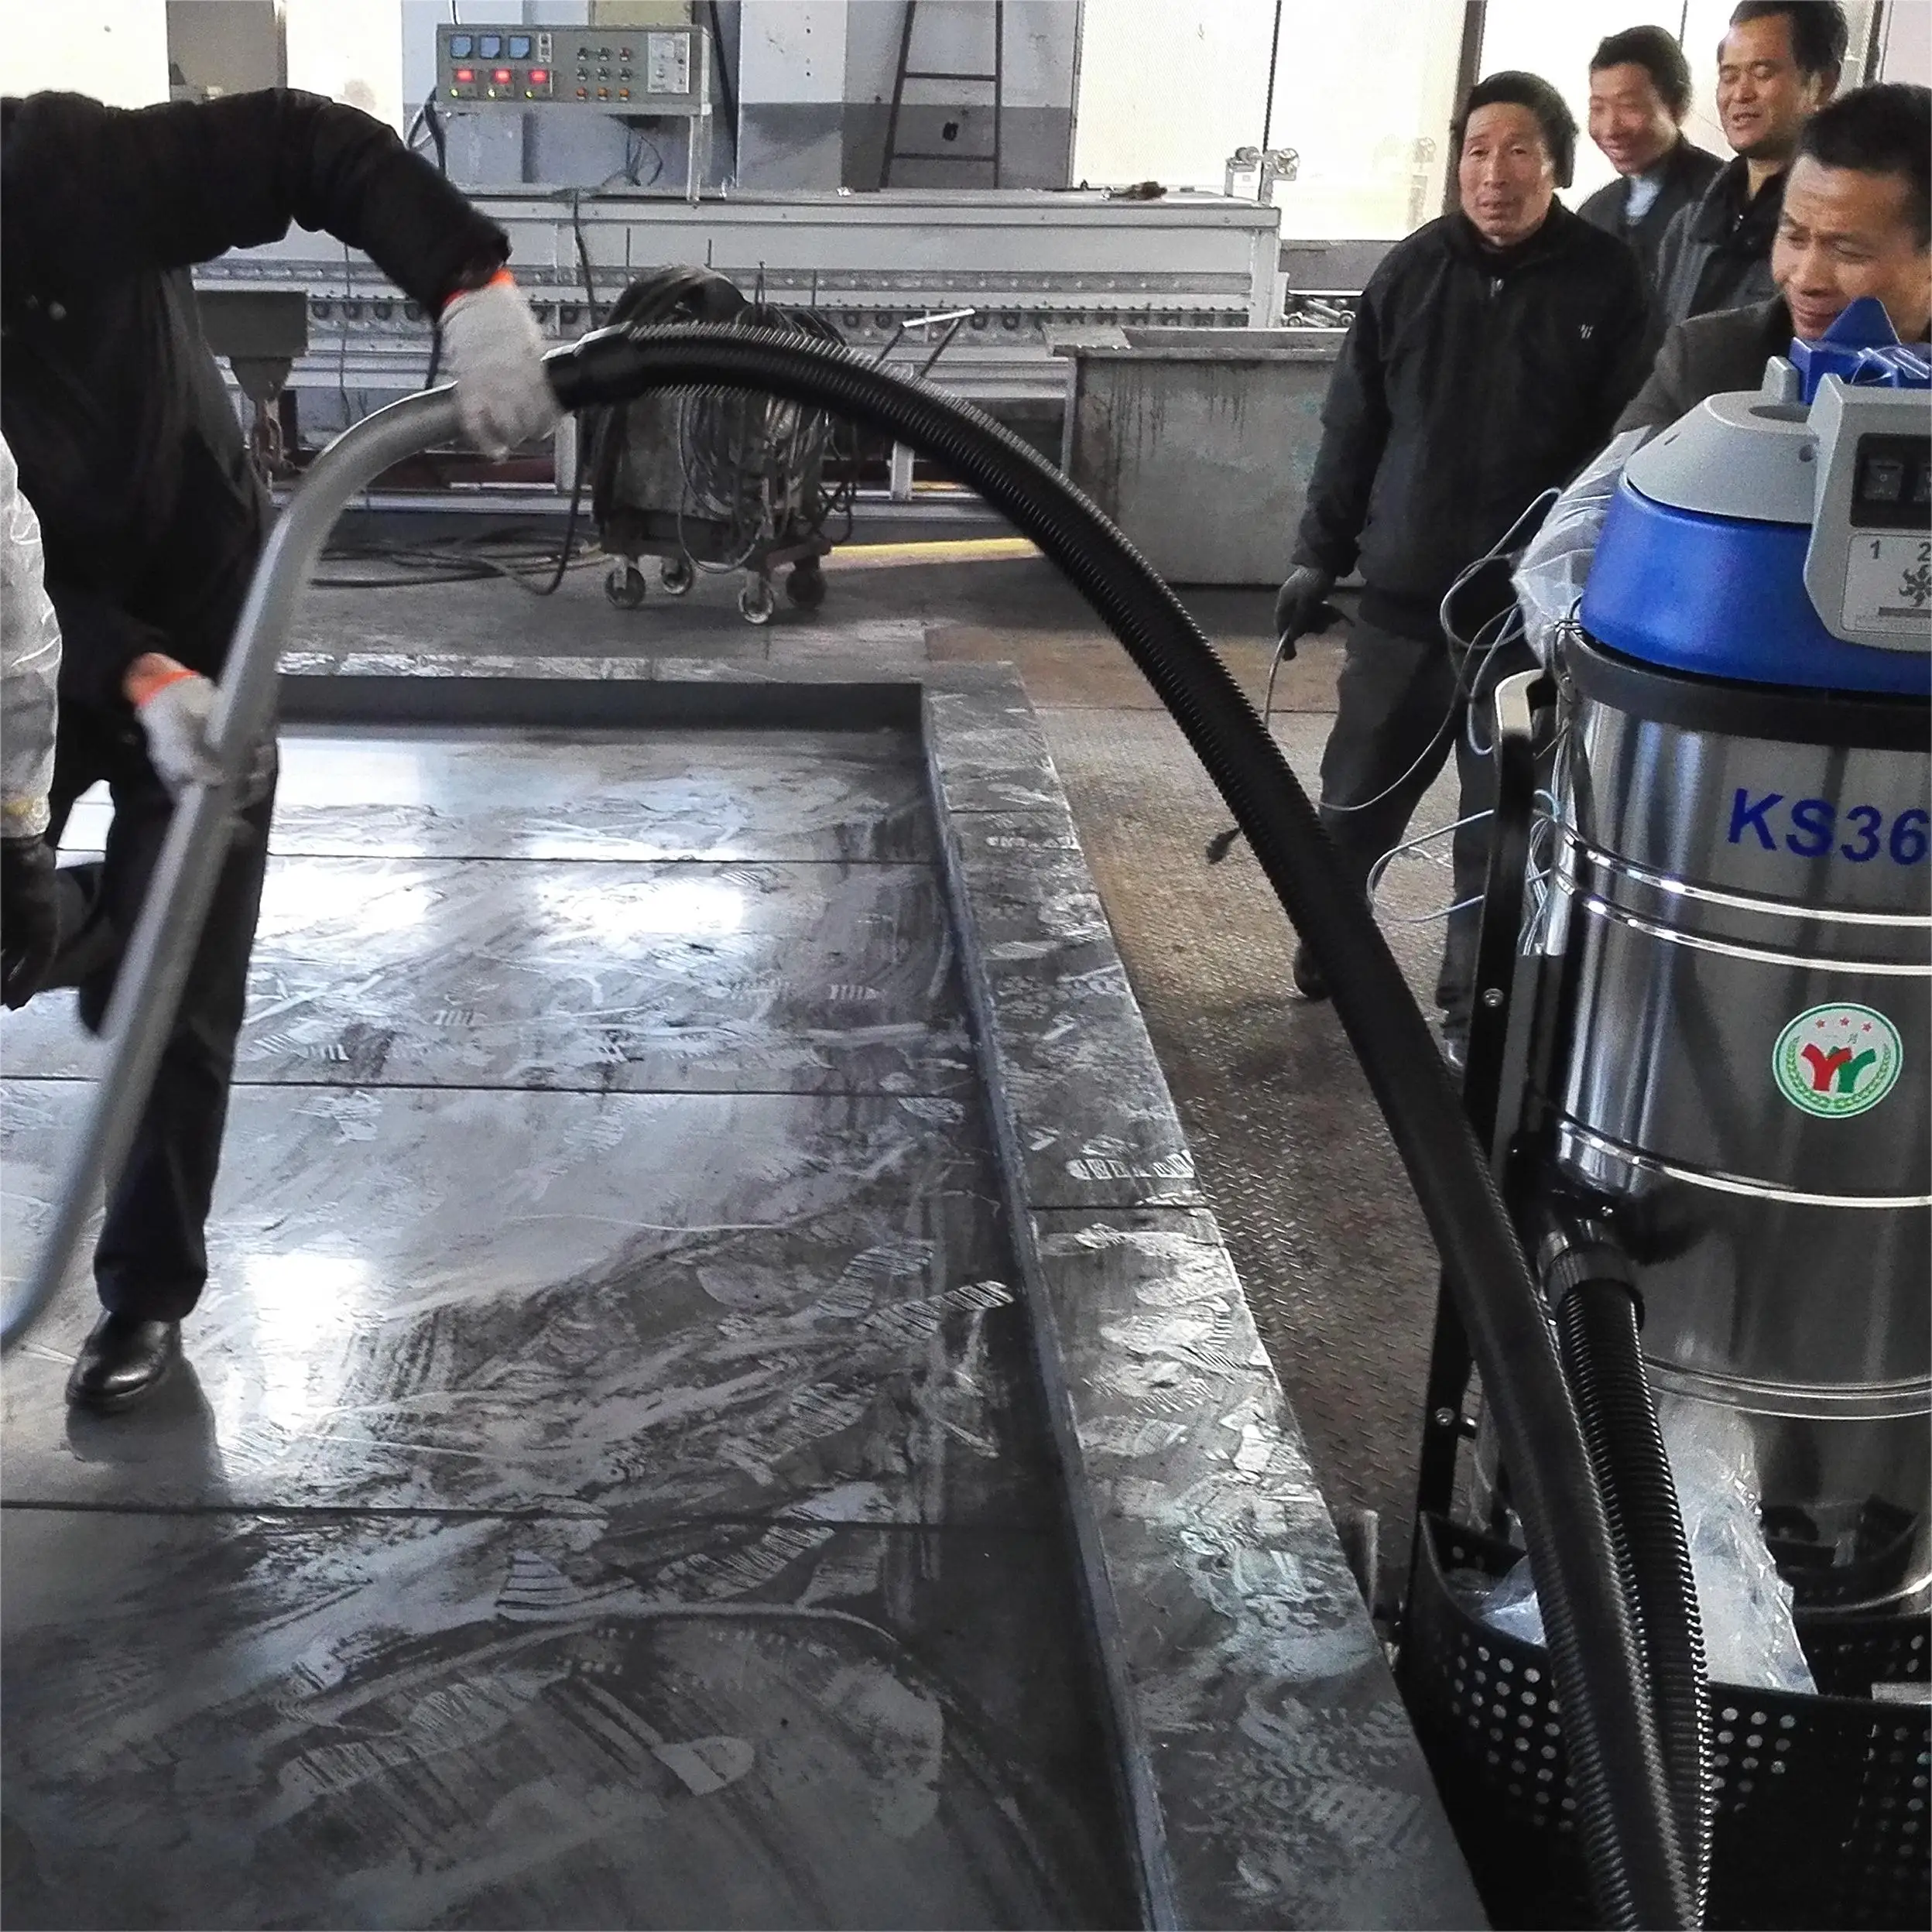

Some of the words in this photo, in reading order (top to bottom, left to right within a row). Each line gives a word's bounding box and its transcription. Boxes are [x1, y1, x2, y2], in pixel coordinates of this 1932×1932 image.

[1870, 540, 1881, 560] 1
[1917, 542, 1931, 562] 2
[1728, 788, 1930, 865] KS36
